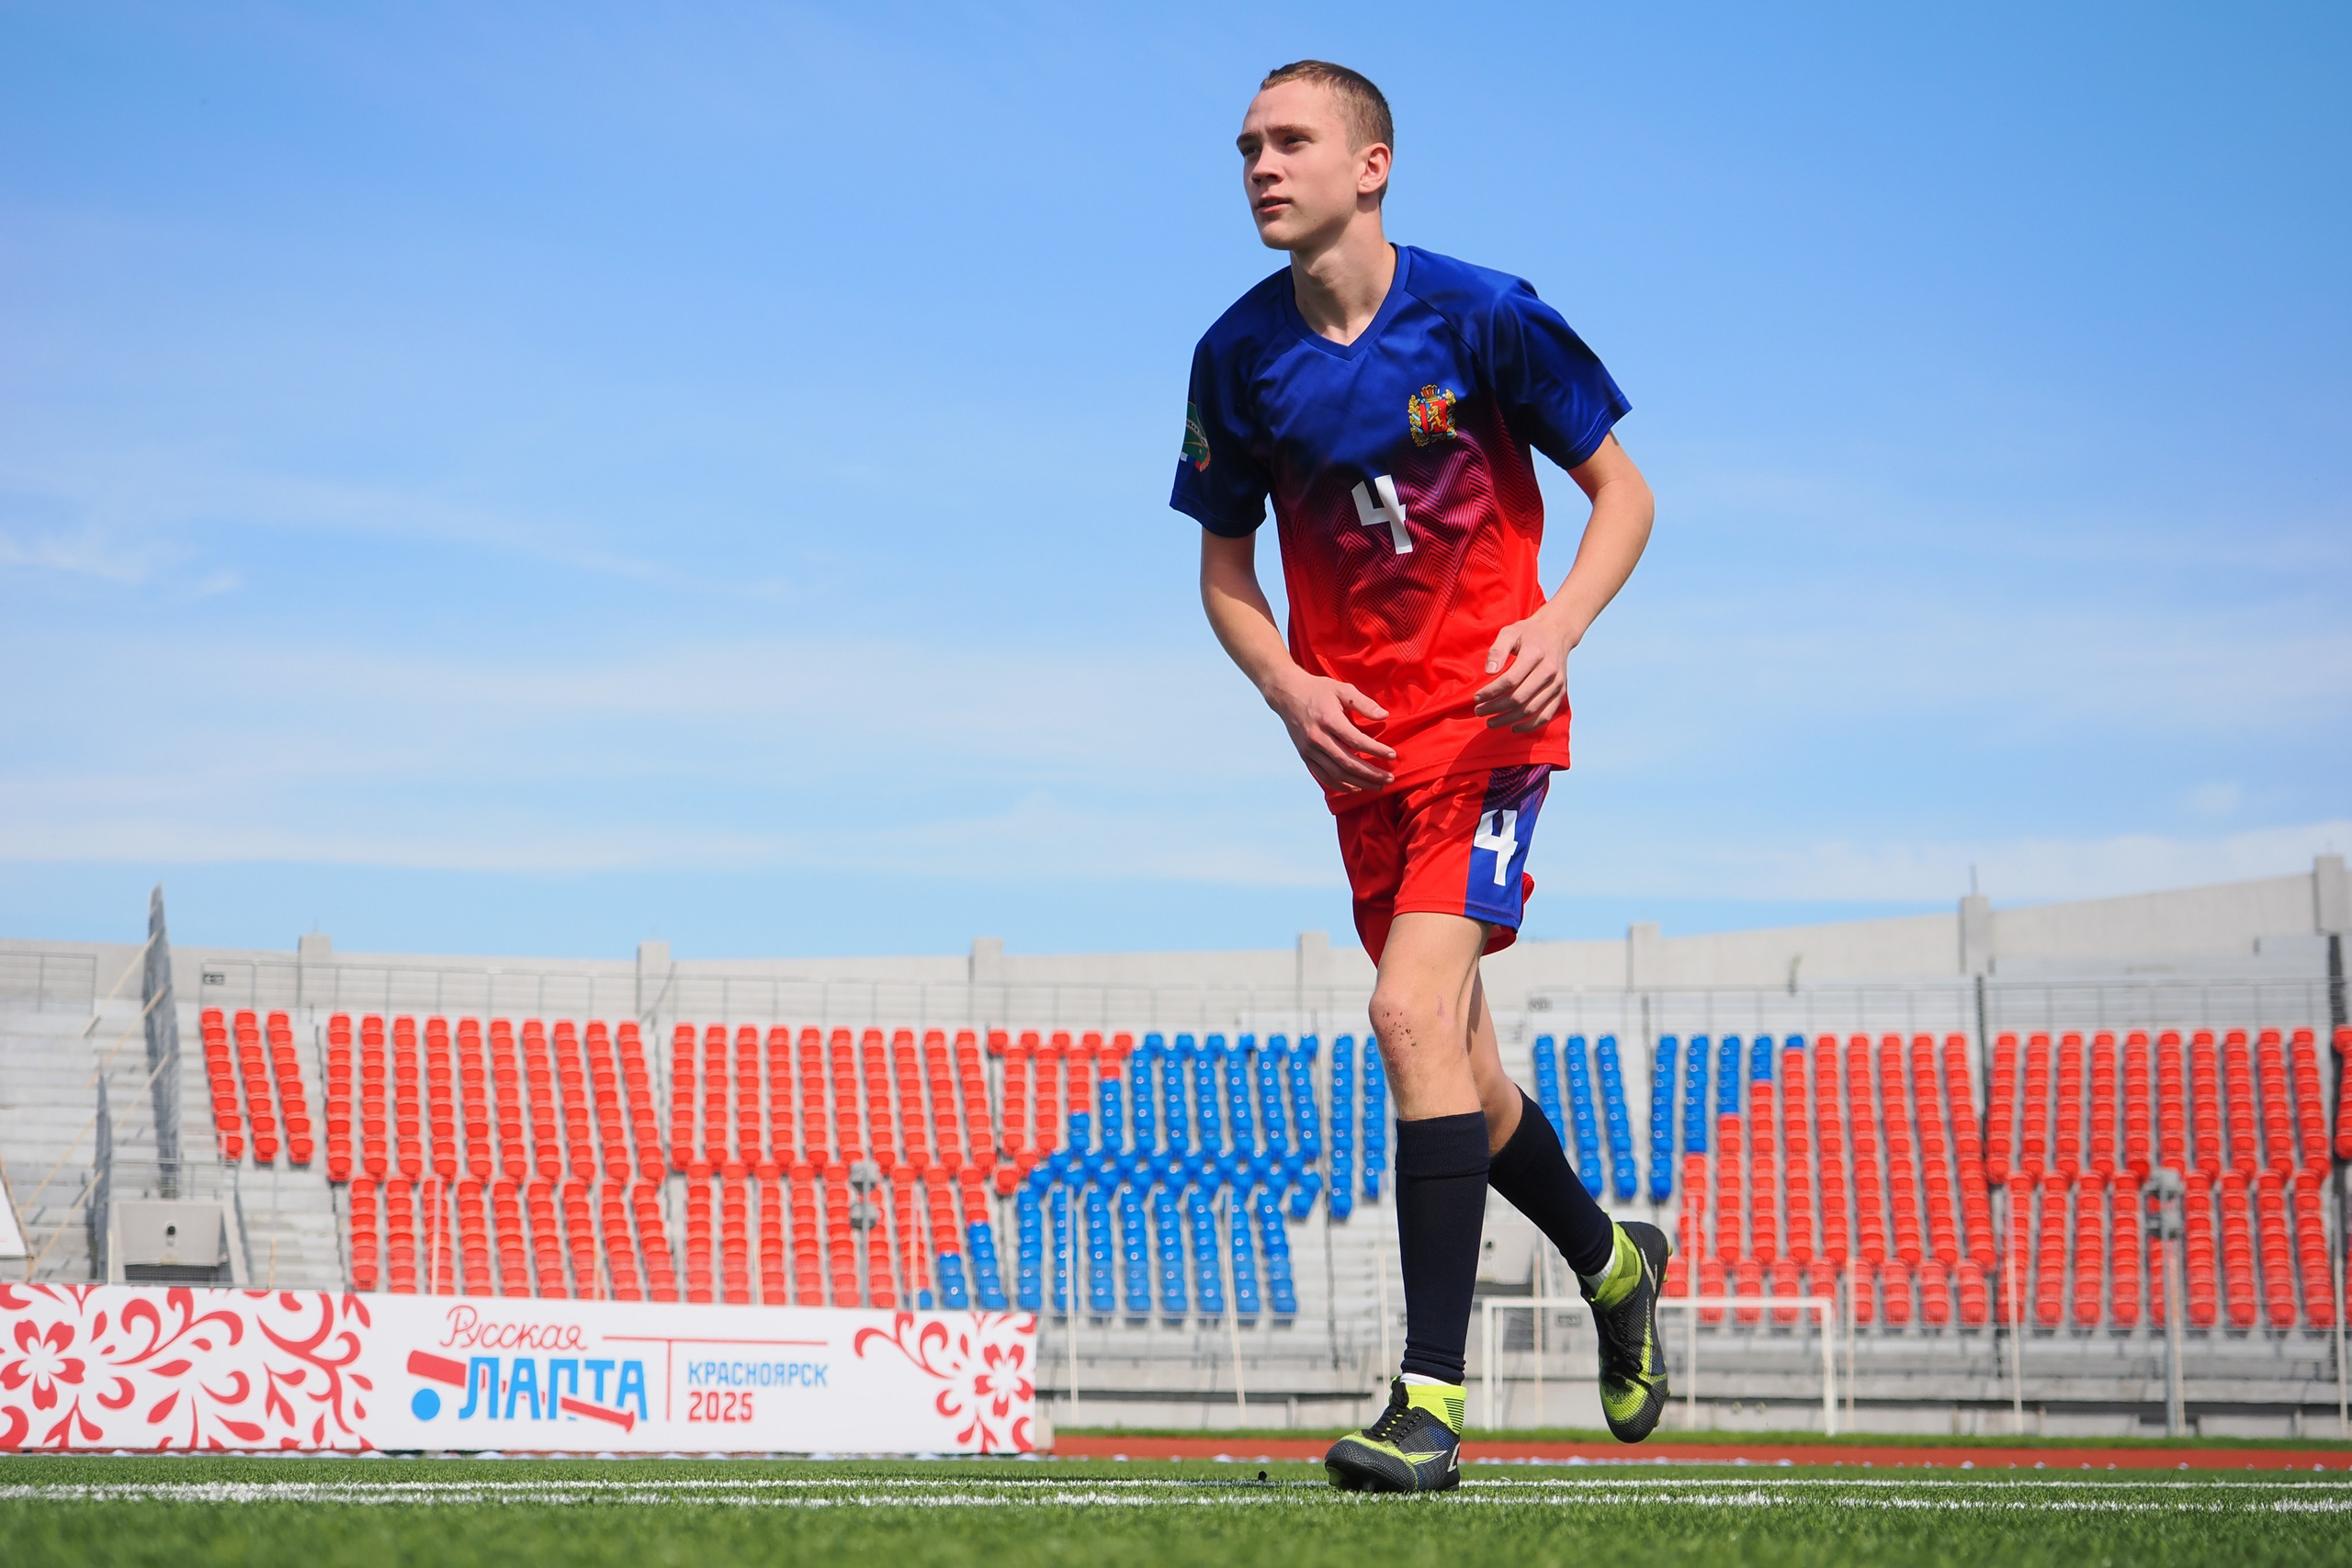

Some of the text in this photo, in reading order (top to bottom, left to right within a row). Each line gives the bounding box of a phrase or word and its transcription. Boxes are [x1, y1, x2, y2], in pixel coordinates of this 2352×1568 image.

[1351, 474, 1413, 555] 4
[1474, 809, 1518, 886] 4
[439, 1304, 588, 1350] Русская
[458, 1357, 648, 1421] ЛАПТА
[688, 1361, 828, 1387] КРАСНОЯРСК
[689, 1391, 752, 1422] 2025
